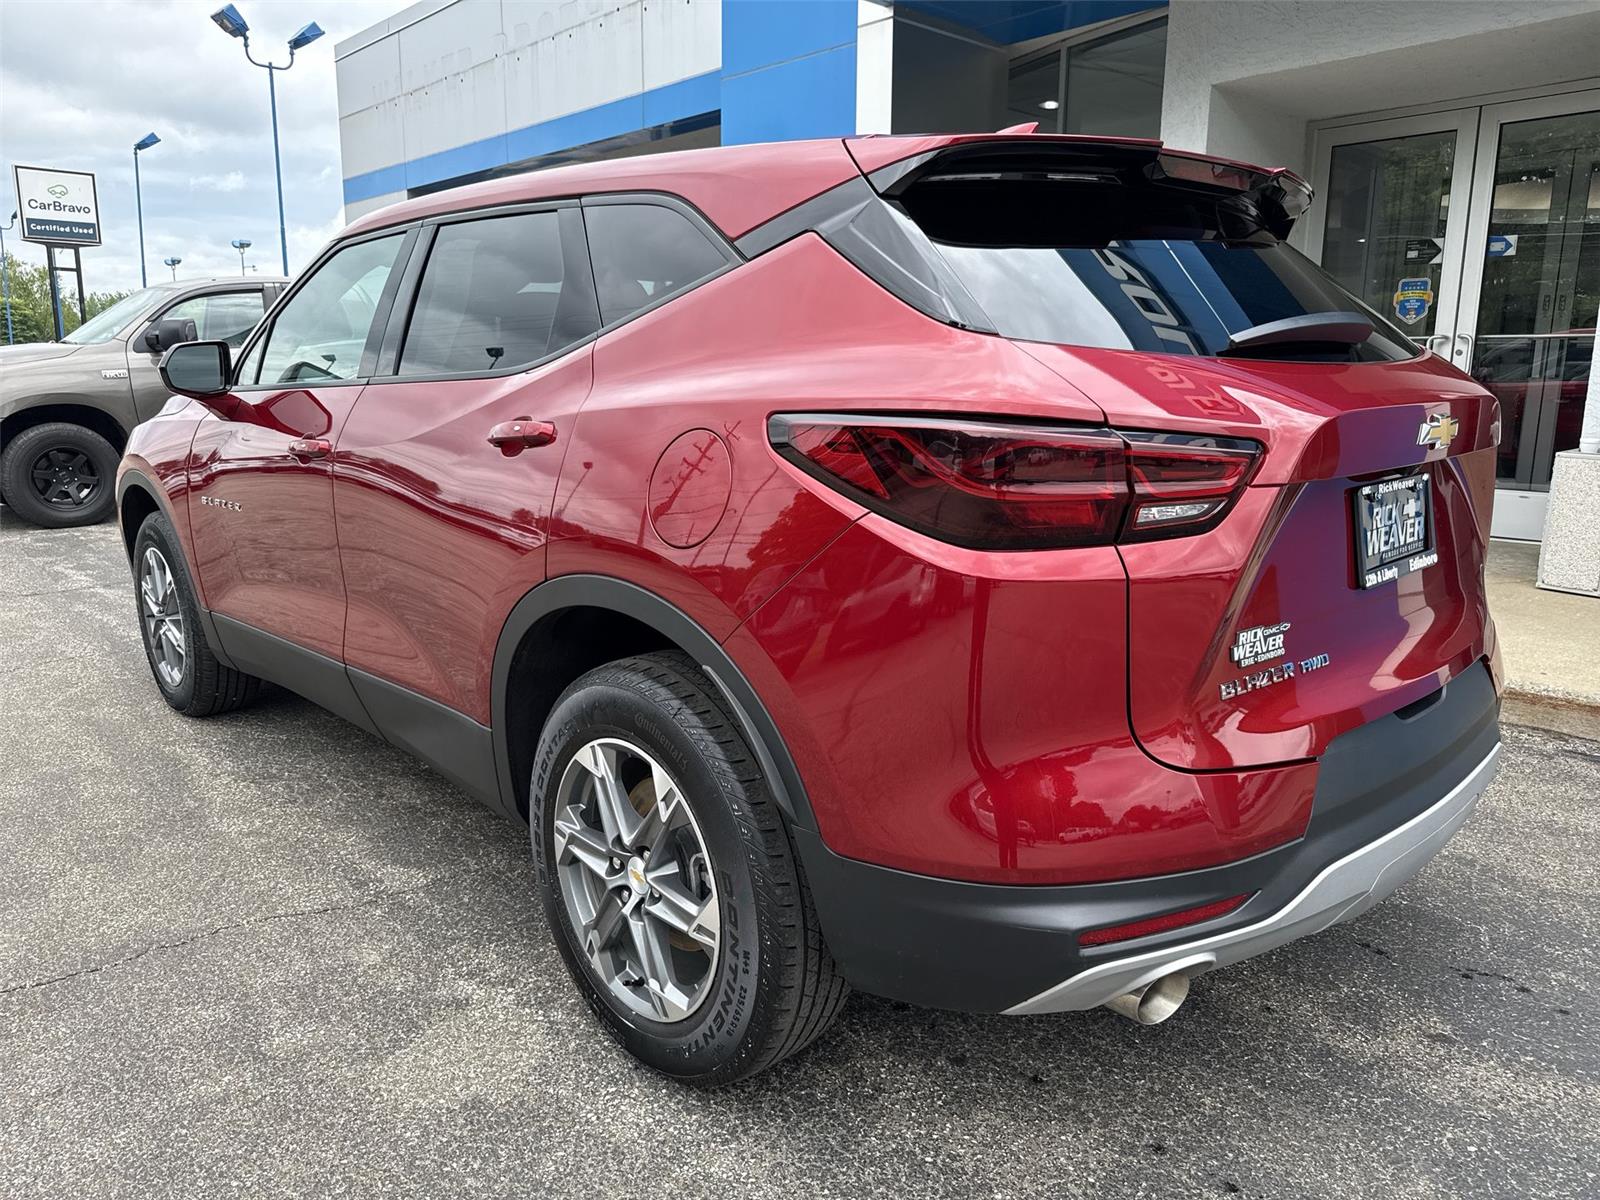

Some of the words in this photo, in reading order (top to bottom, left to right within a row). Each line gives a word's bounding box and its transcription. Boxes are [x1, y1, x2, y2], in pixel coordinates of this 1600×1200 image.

[28, 198, 91, 214] CarBravo
[30, 223, 71, 233] Certified
[72, 225, 94, 234] Used
[201, 496, 243, 512] BLAZER
[1372, 502, 1401, 530] RICK
[1367, 516, 1425, 557] WEAVER
[1233, 633, 1284, 661] WEAVER
[1239, 627, 1265, 646] RICK
[1263, 625, 1280, 636] GMC
[1241, 656, 1255, 667] ERIE
[1257, 648, 1285, 663] EDINBORO
[1220, 662, 1295, 700] BLAZER
[1298, 653, 1330, 674] AWD
[634, 711, 683, 763] Continental
[669, 870, 740, 1058] CONTINENTA
